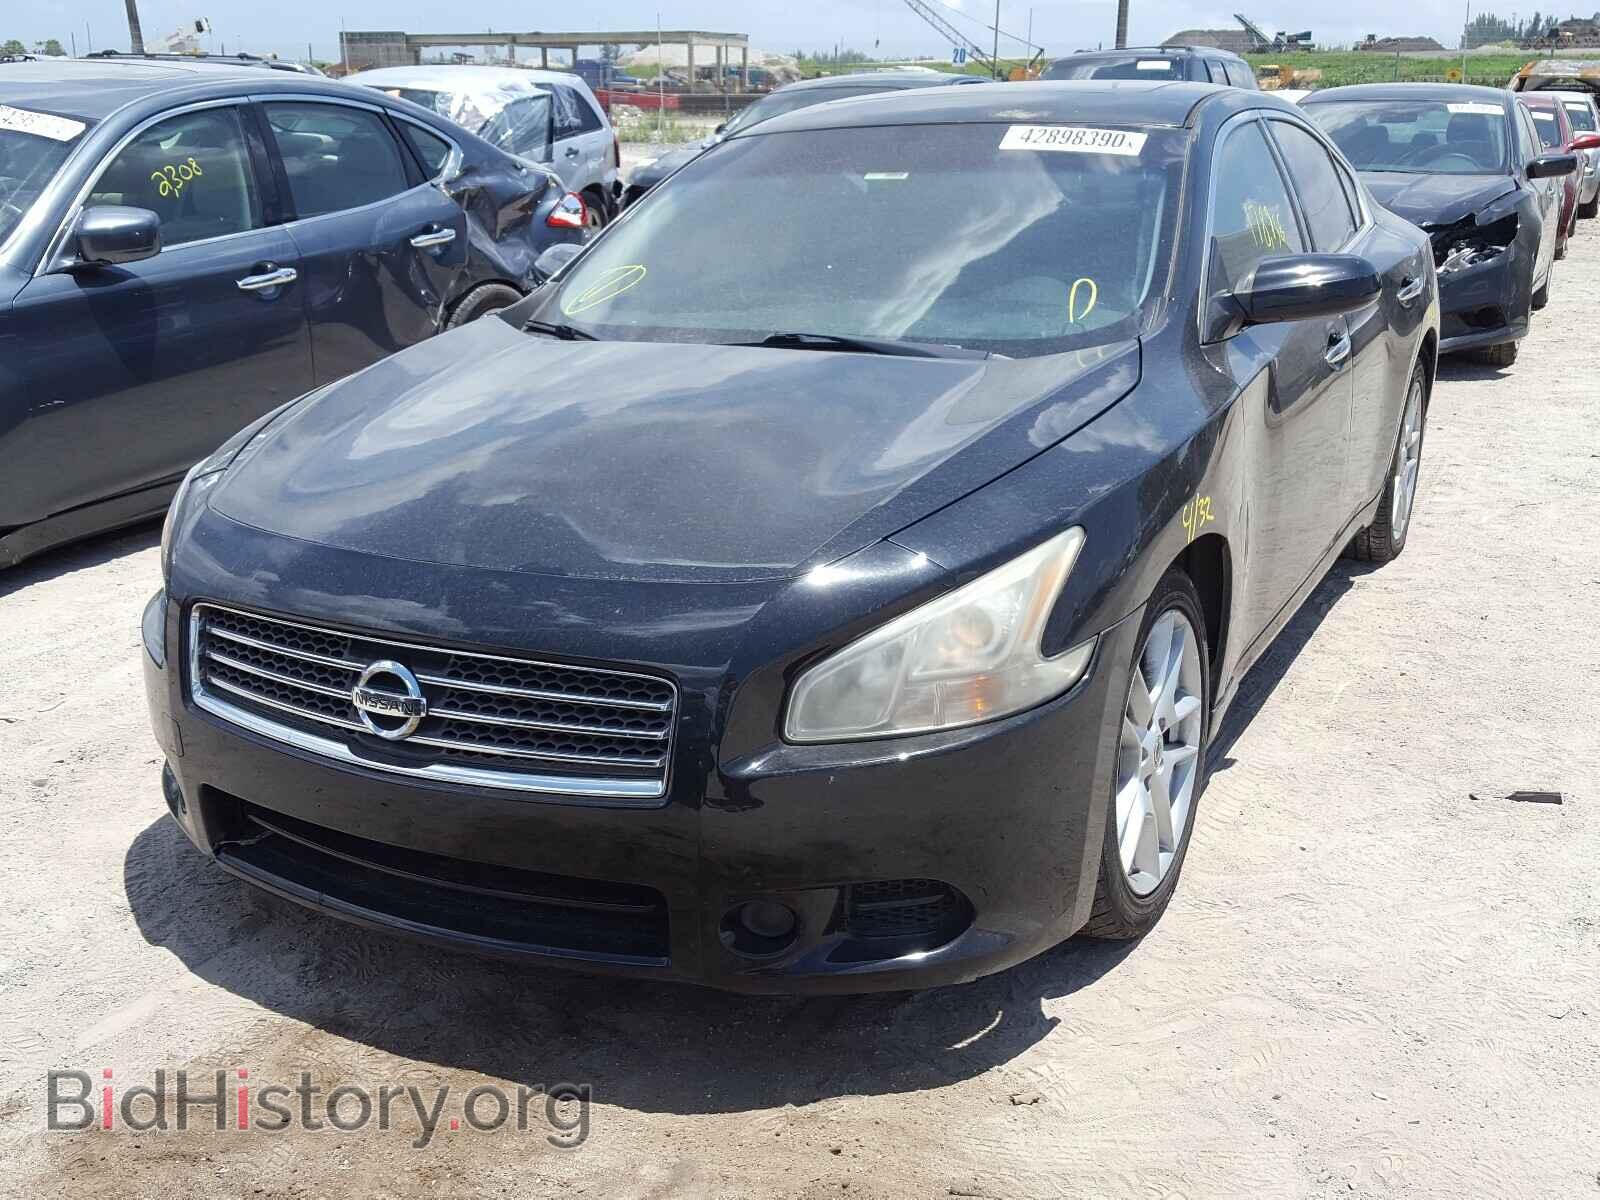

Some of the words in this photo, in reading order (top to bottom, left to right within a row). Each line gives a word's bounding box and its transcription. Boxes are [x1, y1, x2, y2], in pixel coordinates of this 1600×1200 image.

[953, 47, 966, 63] 20
[1020, 127, 1126, 148] 42898390
[353, 688, 418, 715] NISSAN
